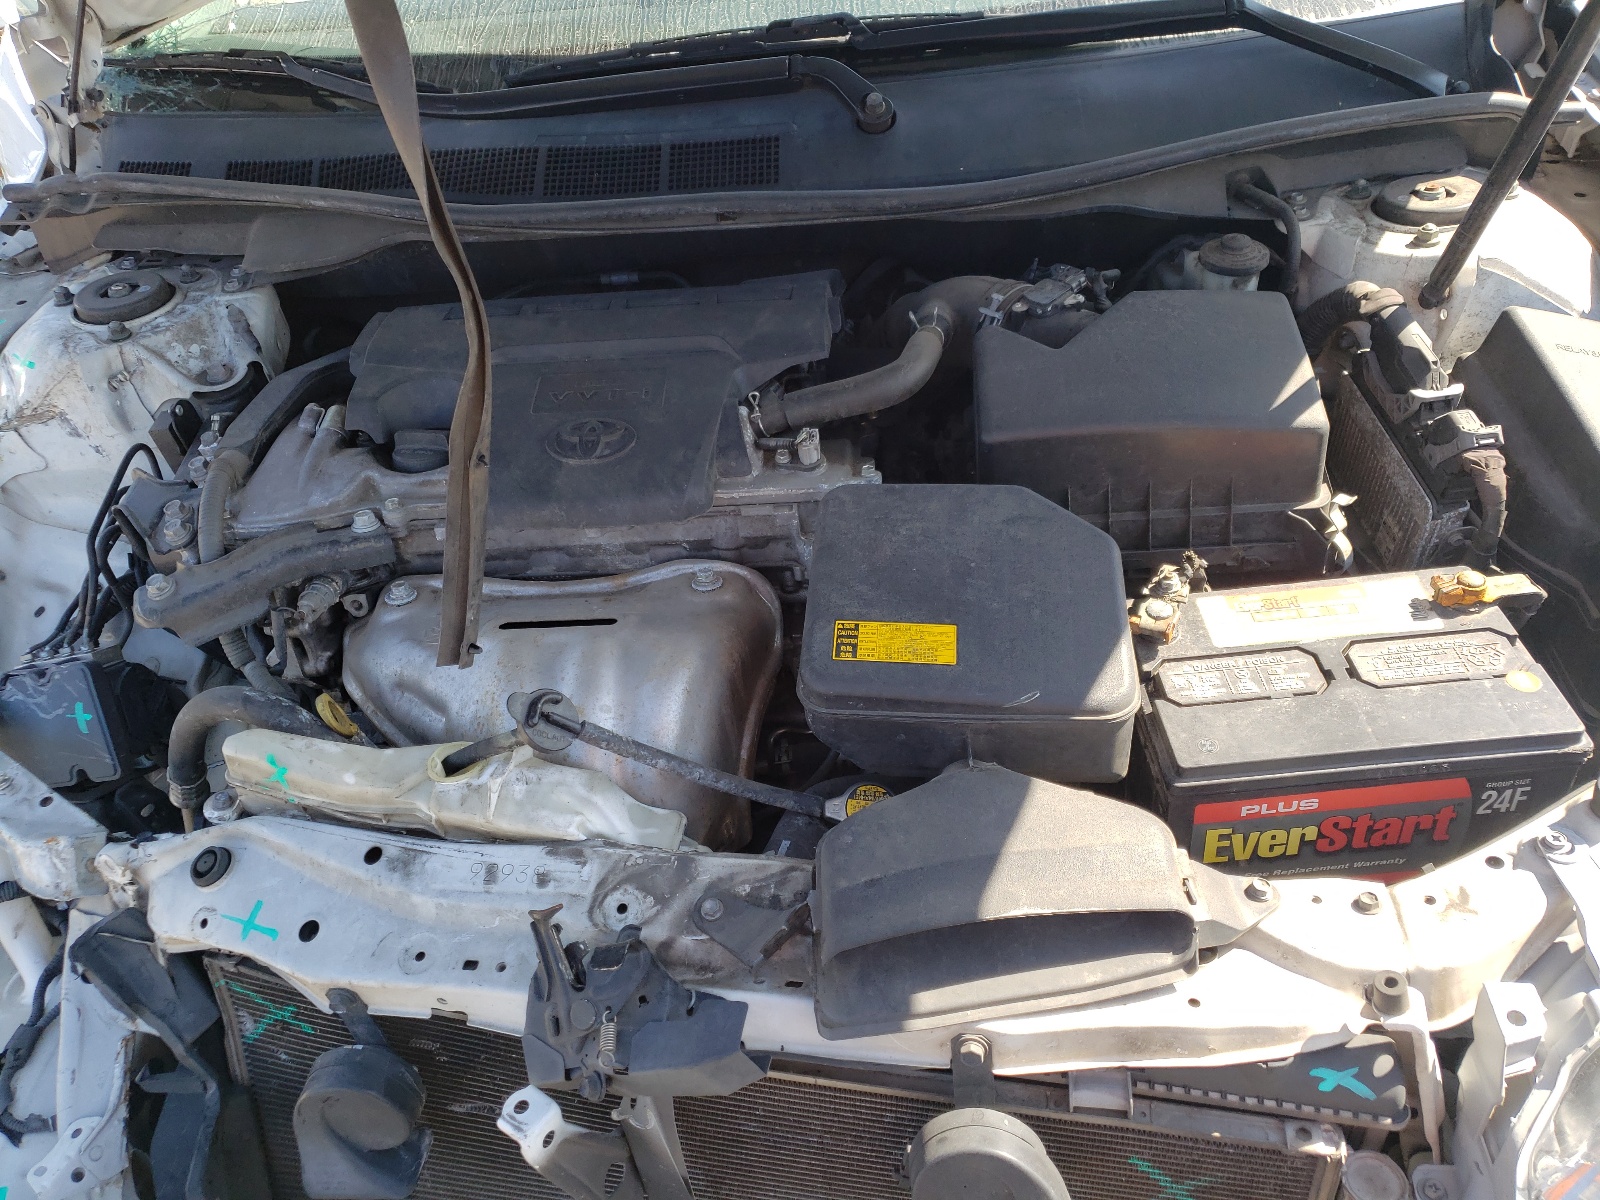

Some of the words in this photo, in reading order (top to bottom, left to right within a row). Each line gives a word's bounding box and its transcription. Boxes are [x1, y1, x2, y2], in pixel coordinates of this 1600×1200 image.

[1486, 780, 1513, 788] GROUP
[1514, 778, 1532, 786] SIZE
[1241, 798, 1320, 817] PLUS
[1476, 786, 1532, 815] 24F
[1203, 804, 1458, 864] EverStart
[1272, 862, 1350, 876] Replacement
[1353, 856, 1407, 869] Warranty
